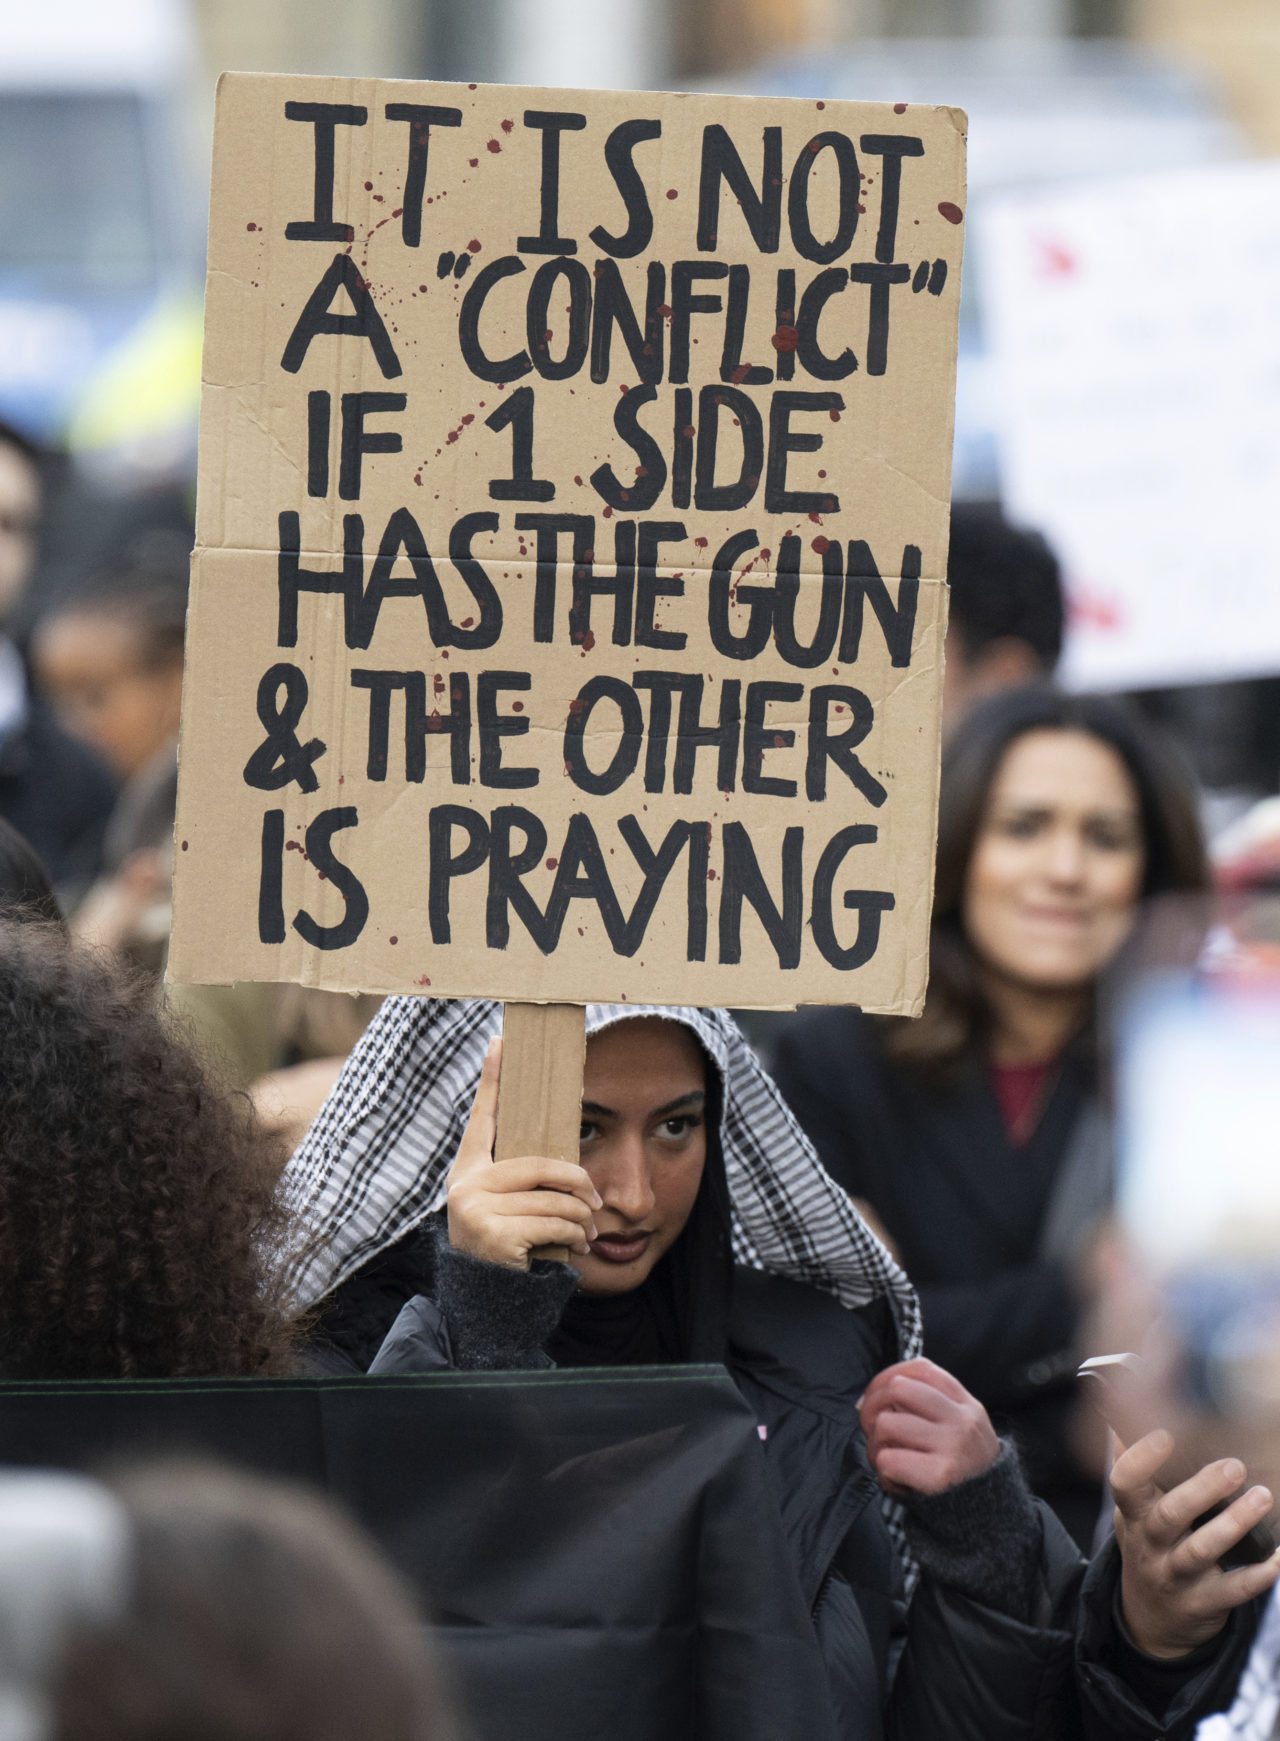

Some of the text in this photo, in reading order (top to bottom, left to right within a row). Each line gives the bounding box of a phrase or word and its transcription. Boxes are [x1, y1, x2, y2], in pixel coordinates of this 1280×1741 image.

[285, 102, 925, 265] IT IS NOT
[281, 253, 403, 380] A
[437, 250, 948, 385] "CONFLICT"
[308, 384, 847, 515] IF 1 SIDE
[278, 507, 922, 669] HAS THE GUN
[243, 662, 888, 808] & THE OTHER
[258, 804, 896, 971] IS PRAYING
